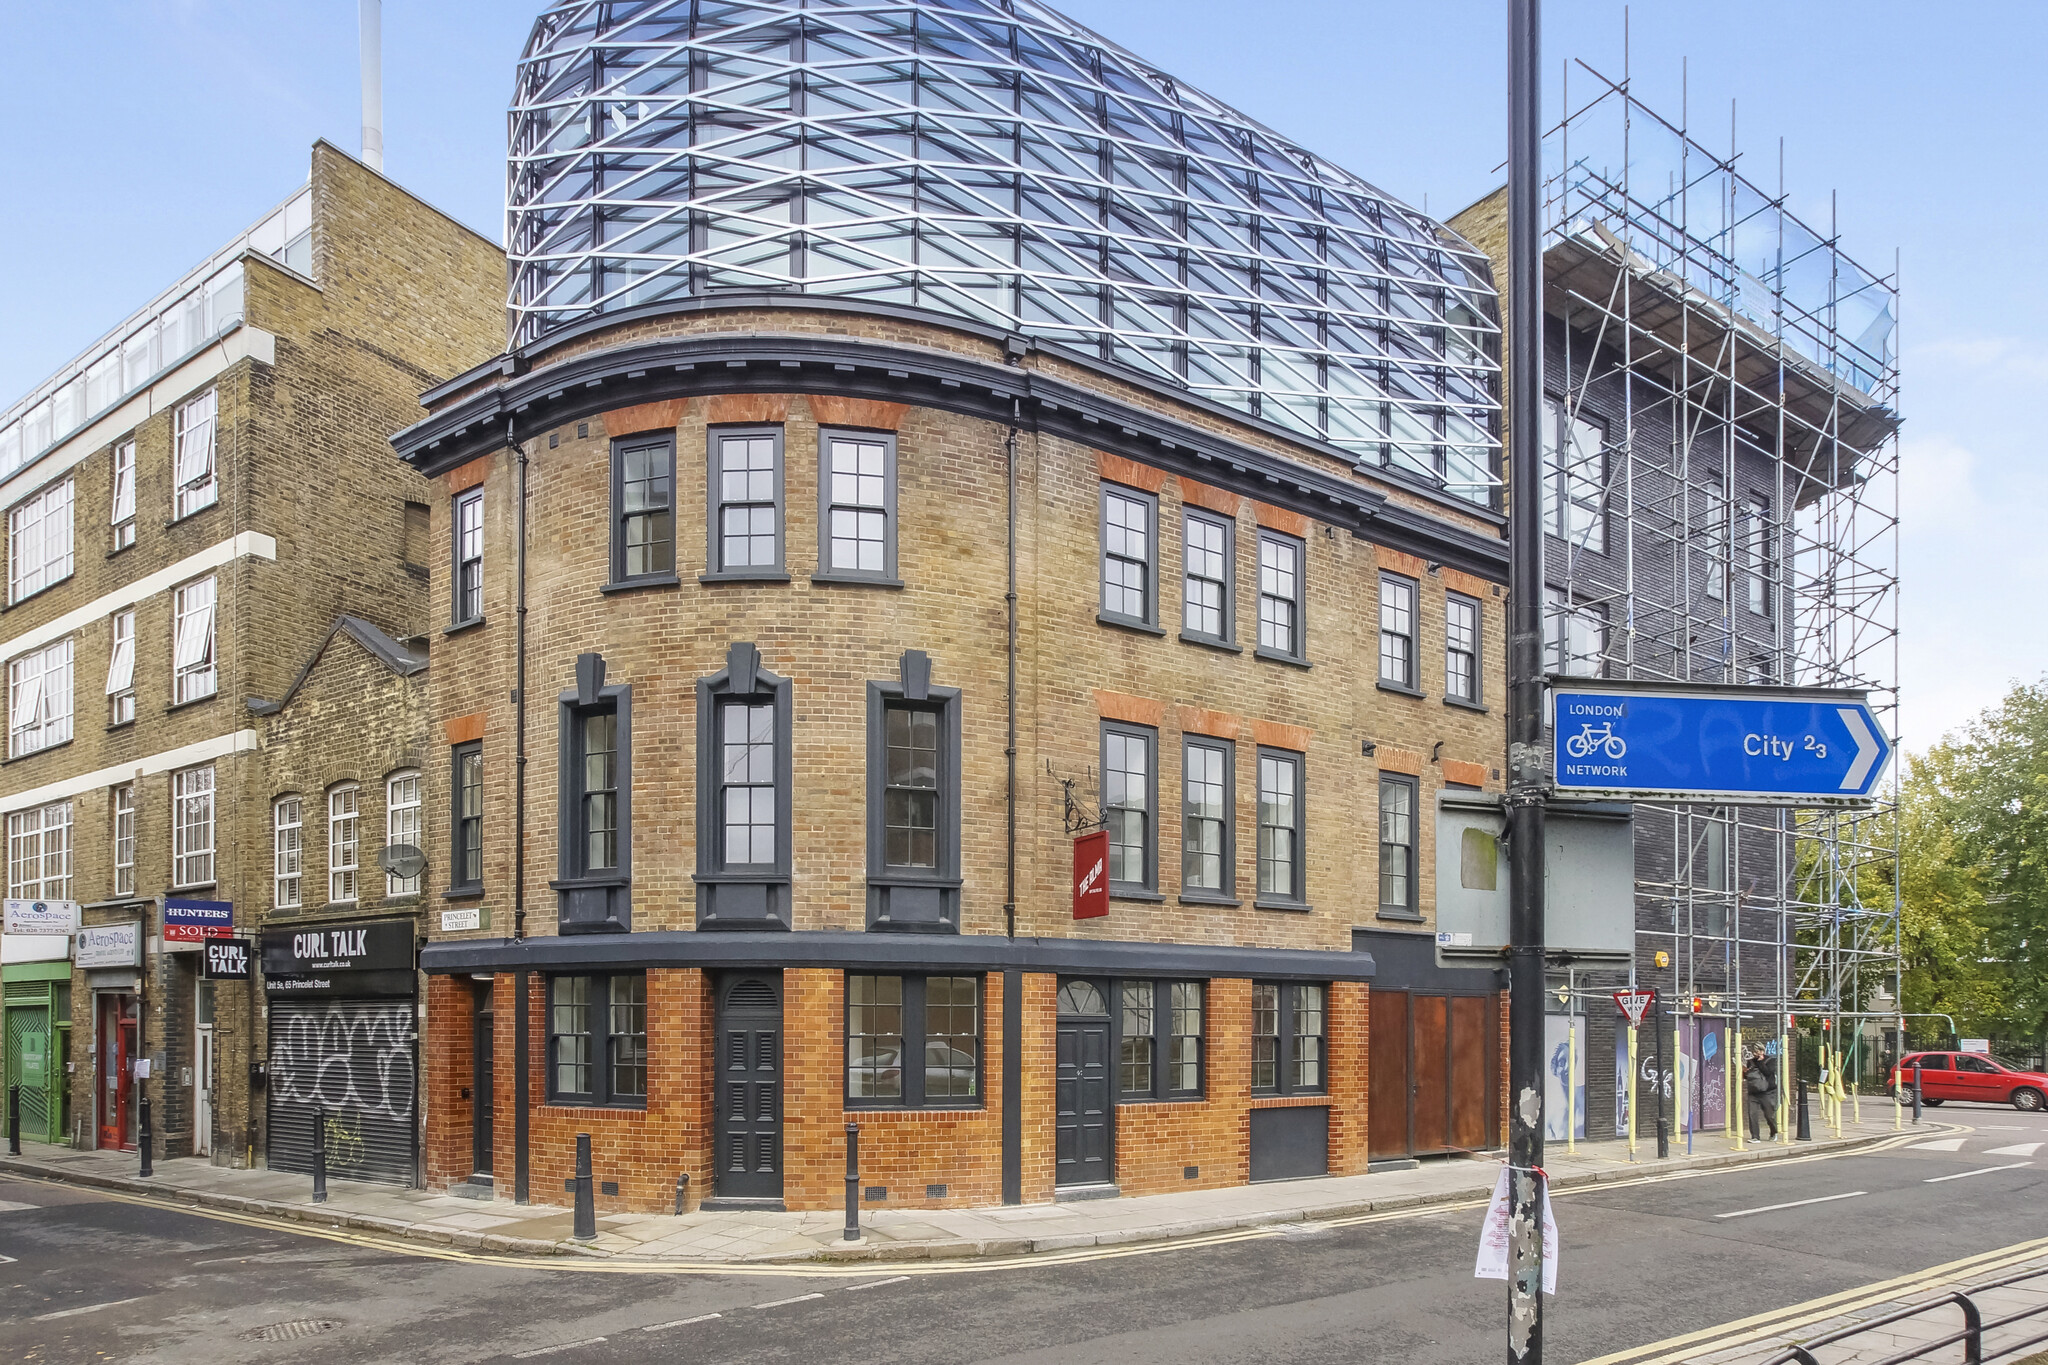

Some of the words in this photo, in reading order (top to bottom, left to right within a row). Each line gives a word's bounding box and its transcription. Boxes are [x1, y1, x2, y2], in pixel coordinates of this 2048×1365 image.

[1569, 704, 1622, 716] LONDON
[1743, 733, 1795, 762] City
[1566, 764, 1628, 777] NETWORK
[10, 910, 72, 920] Aerospace
[167, 907, 229, 919] HUNTERS
[444, 912, 473, 921] PRINCELET
[448, 921, 468, 929] STREET
[179, 926, 219, 937] SOLD
[88, 930, 133, 947] Aerospace
[294, 933, 329, 958] CURL
[331, 929, 367, 957] TALK
[208, 945, 248, 960] CURL
[209, 959, 247, 974] TALK
[267, 980, 276, 990] Unit
[292, 980, 314, 989] Princelet
[314, 979, 330, 988] Street
